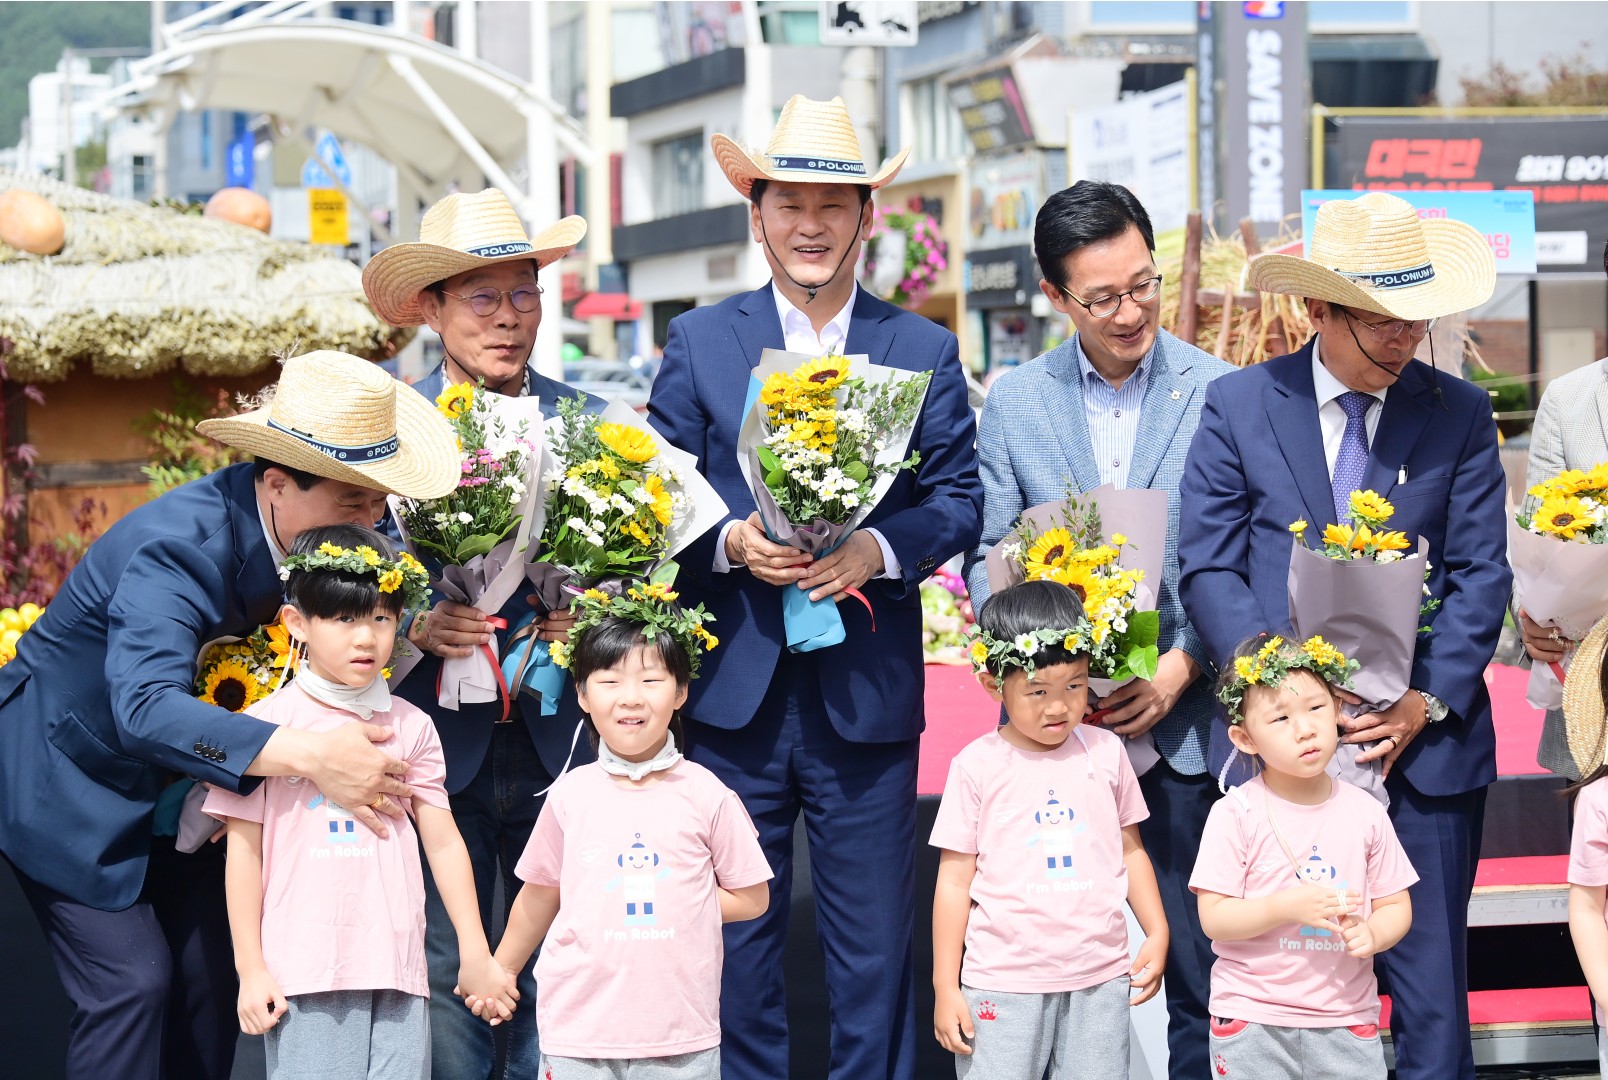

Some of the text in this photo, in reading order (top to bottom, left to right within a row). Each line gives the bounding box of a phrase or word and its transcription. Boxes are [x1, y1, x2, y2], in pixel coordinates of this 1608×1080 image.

[1564, 155, 1608, 181] 90
[1375, 268, 1429, 285] POLONIUM
[309, 845, 375, 859] I'm Robot
[1026, 878, 1094, 894] I'm Robot
[604, 927, 676, 941] I'm Robot
[1279, 937, 1347, 951] I'm Robot
